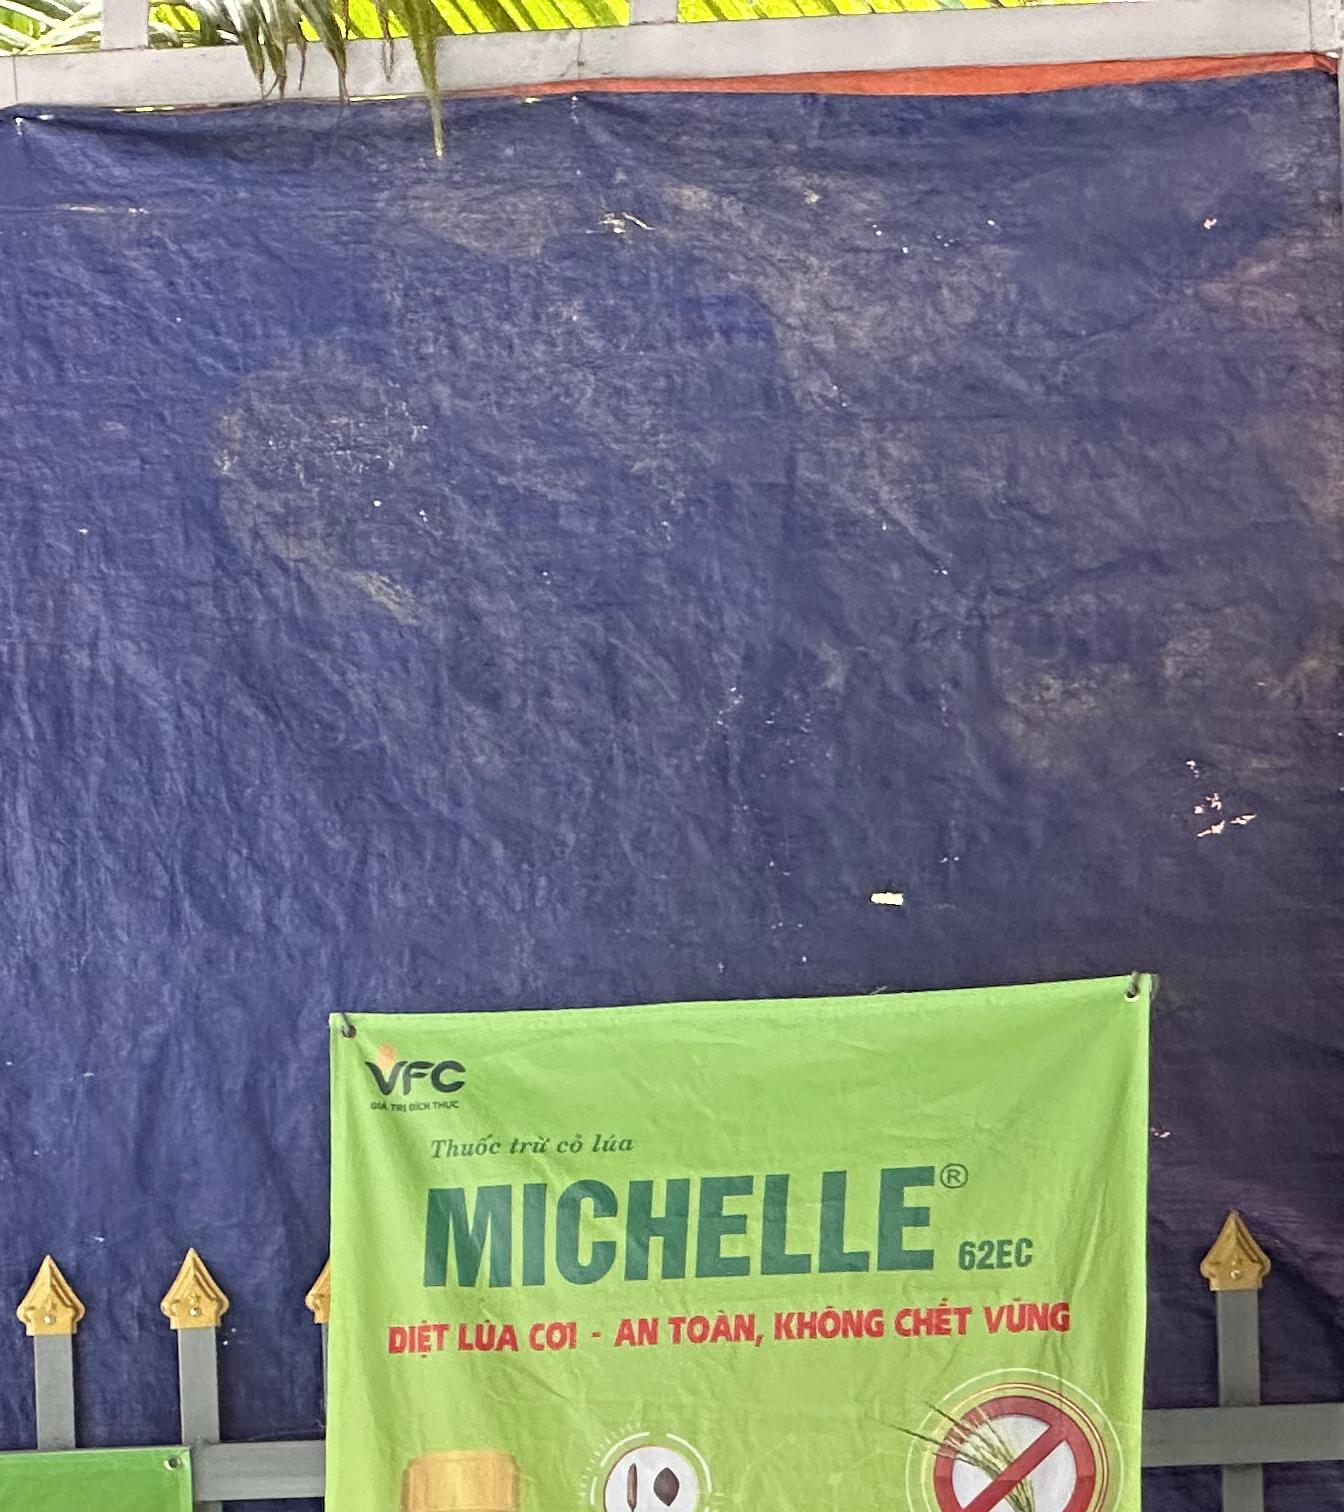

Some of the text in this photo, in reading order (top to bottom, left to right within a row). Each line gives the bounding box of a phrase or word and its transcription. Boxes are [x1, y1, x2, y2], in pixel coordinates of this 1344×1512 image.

[364, 1060, 466, 1096] VFC
[431, 1133, 634, 1158] Thuốc trừ cỏ lúa
[958, 1237, 1033, 1270] 62EC
[388, 1321, 450, 1358] DIỆT
[458, 1319, 519, 1352] LÚA
[614, 1317, 660, 1348] AN
[669, 1310, 763, 1348] TOÀN,
[774, 1306, 885, 1340] KHÔNG
[894, 1297, 972, 1337] CHẾT
[983, 1297, 1071, 1334] VŨNG
